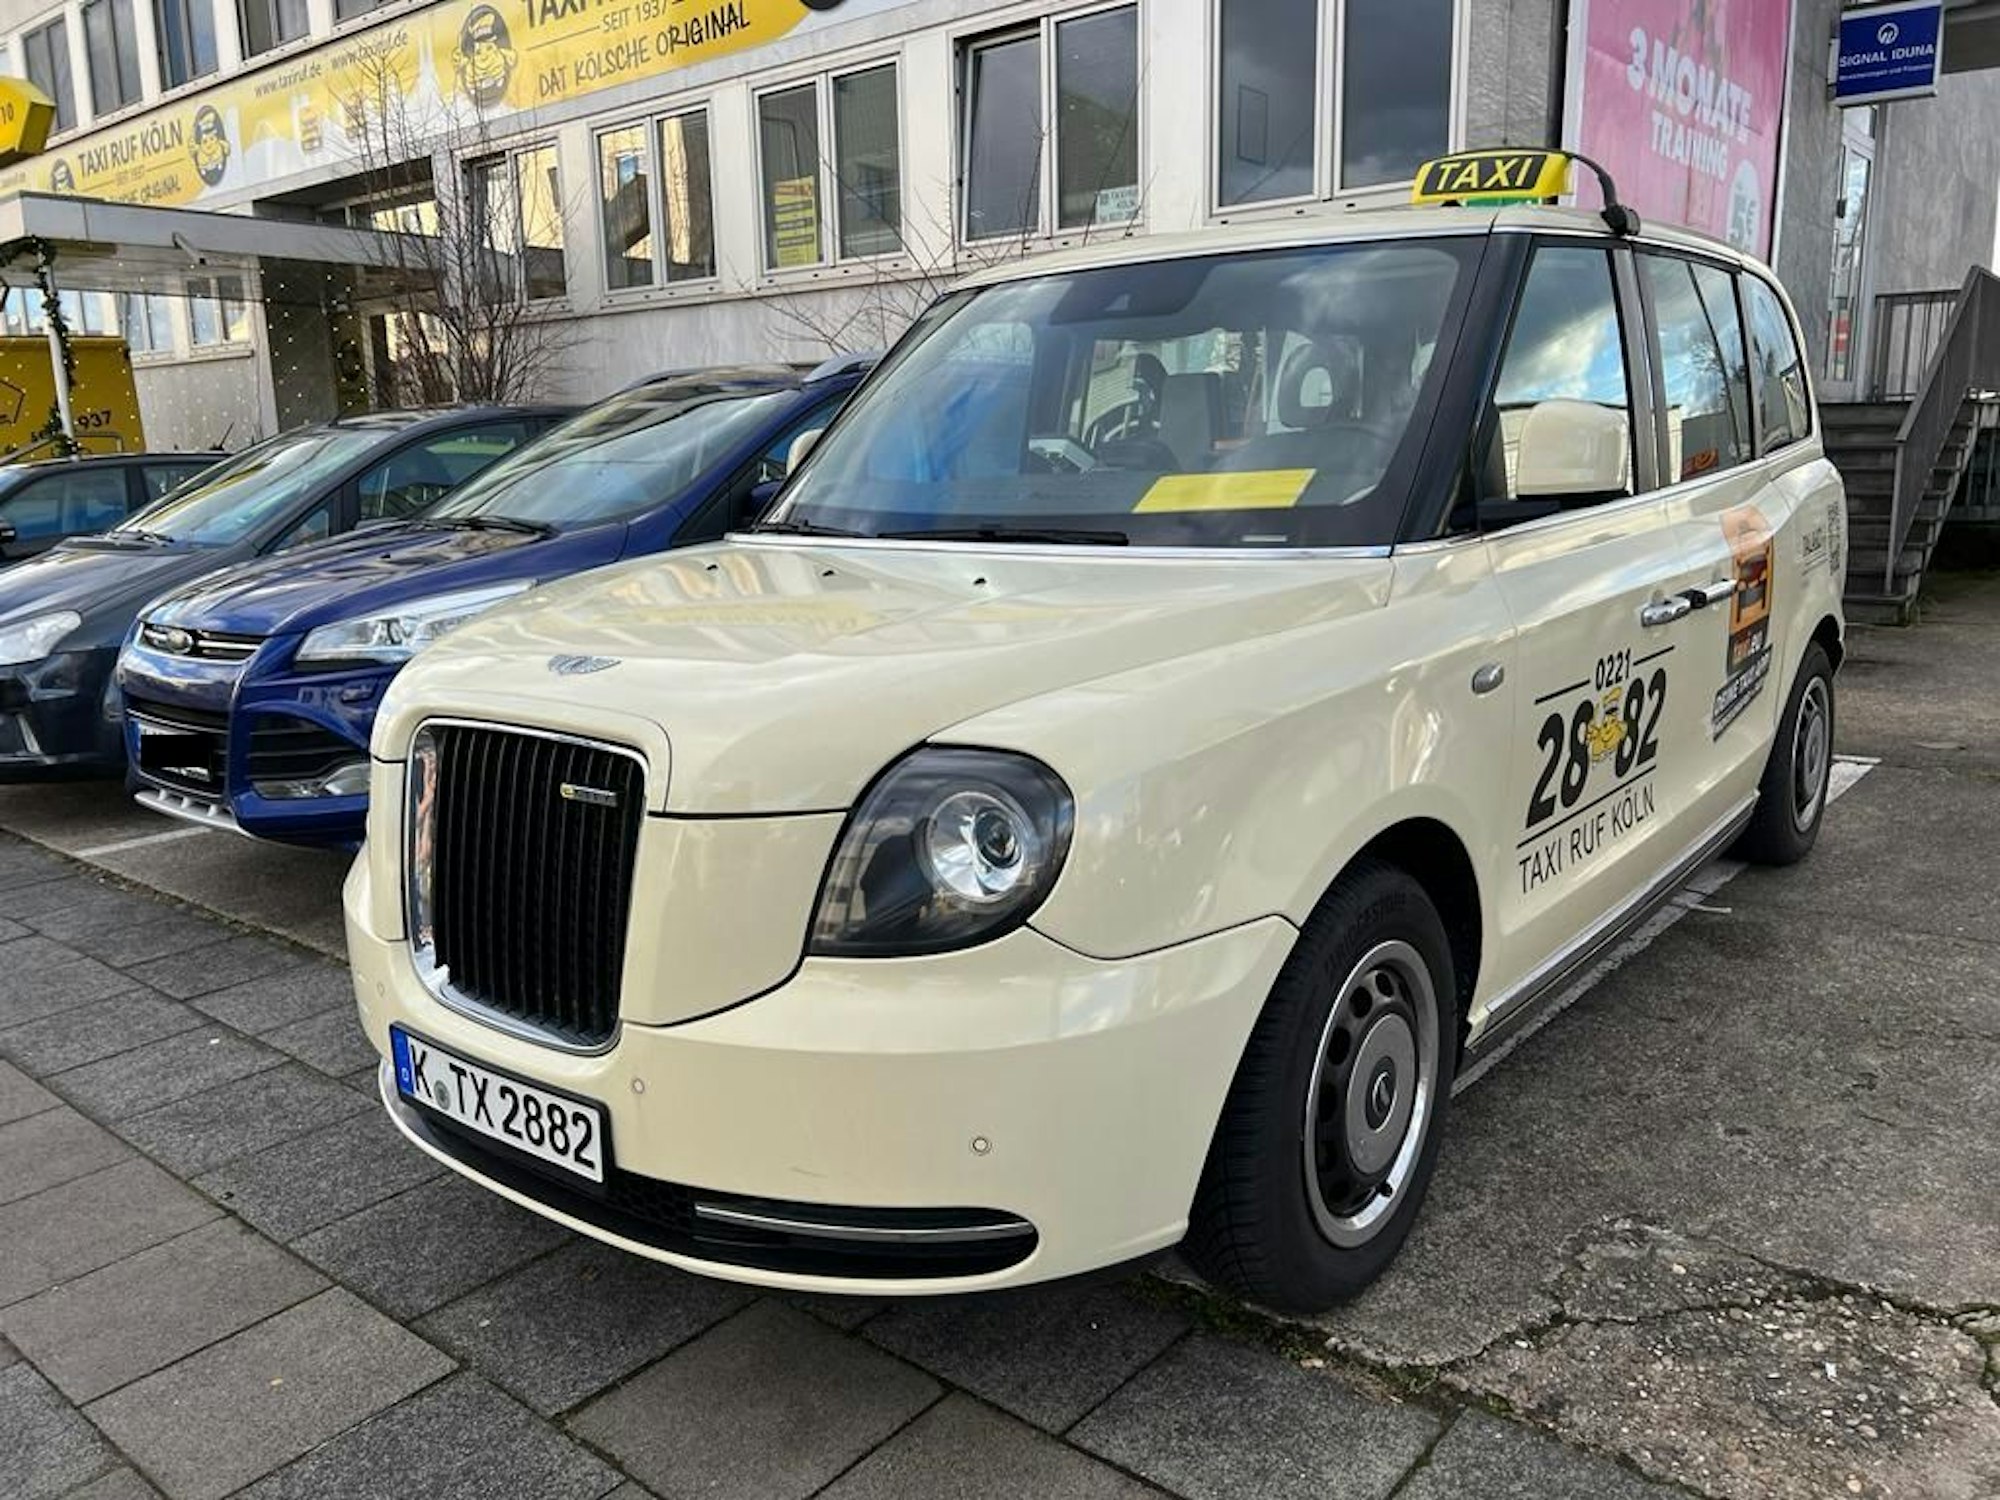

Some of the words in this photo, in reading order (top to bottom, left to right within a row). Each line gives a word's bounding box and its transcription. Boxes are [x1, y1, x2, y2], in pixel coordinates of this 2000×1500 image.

[602, 10, 632, 33] SEIT
[634, 0, 668, 24] 1937
[538, 66, 567, 98] DAT
[574, 34, 651, 86] KÖLSCHE
[655, 2, 751, 56] ORIGINAL
[1839, 51, 1887, 68] SIGNAL
[1891, 43, 1935, 60] IDUNA
[1627, 26, 1647, 91] 3
[1648, 38, 1752, 144] MONATE
[78, 147, 109, 178] TAXI
[110, 138, 138, 168] RUF
[140, 119, 183, 158] KÖLN
[1436, 157, 1533, 191] TAXI
[1651, 108, 1728, 181] TRAINING
[76, 409, 112, 430] 937
[1595, 648, 1631, 691] 0221
[1525, 700, 1594, 829] 28
[1615, 668, 1667, 778] 82
[1518, 838, 1563, 894] TAXI
[1570, 812, 1605, 865] RUF
[1611, 783, 1656, 837] KÖLN
[410, 1044, 432, 1098] K
[449, 1062, 494, 1128] TX
[500, 1085, 596, 1170] 2882
